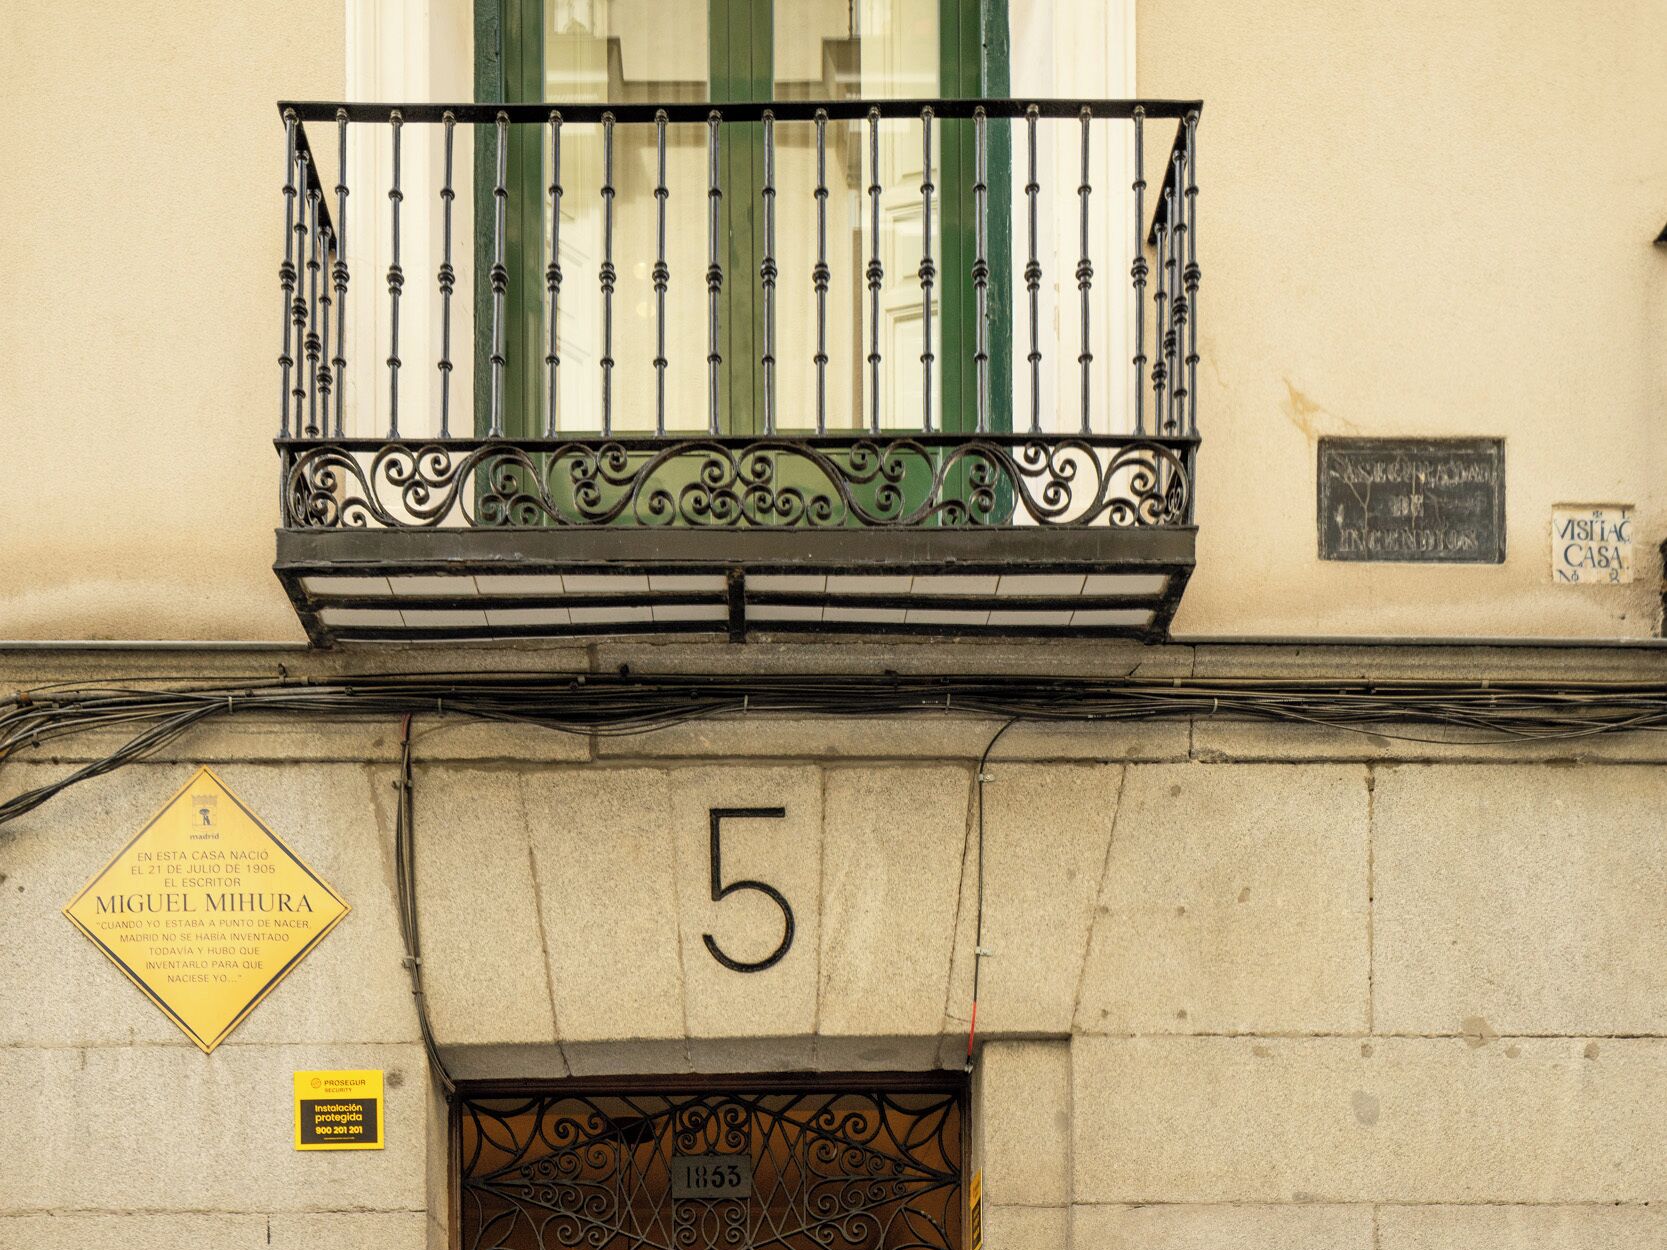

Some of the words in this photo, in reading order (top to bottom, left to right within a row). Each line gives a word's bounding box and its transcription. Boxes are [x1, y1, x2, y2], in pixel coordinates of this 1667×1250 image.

[137, 852, 152, 861] EN
[156, 851, 187, 860] ESTA
[191, 851, 226, 860] CASA
[230, 850, 269, 861] NACIÓ
[131, 865, 144, 875] EL
[148, 865, 161, 875] 21
[167, 865, 183, 874] DE
[186, 864, 221, 874] JULIO
[225, 864, 241, 874] DE
[247, 864, 276, 874] 1905
[164, 878, 178, 887] EL
[182, 878, 241, 887] ESCRITOR
[702, 807, 795, 973] 5
[96, 893, 197, 914] MIGUEL
[205, 893, 314, 912] MIHURA
[146, 920, 161, 928] YO
[165, 919, 205, 928] ESTABA
[208, 919, 216, 928] A
[219, 919, 254, 928] PUNTO
[257, 920, 272, 928] DE
[120, 934, 159, 943] MADRID
[162, 934, 177, 942] NO
[180, 933, 192, 942] SE
[195, 931, 227, 942] HABÍA
[230, 933, 290, 942] INVENTADO
[149, 945, 194, 956] TODAVÍA
[197, 946, 205, 955] Y
[207, 947, 236, 955] HUBO
[239, 947, 261, 956] QUE
[146, 961, 209, 970] INVENTARLO
[211, 960, 239, 969] PARA
[242, 961, 264, 970] QUE
[167, 974, 209, 983] NACIESE
[324, 1079, 366, 1087] PROSEGUR
[314, 1103, 363, 1113] Instalación
[315, 1112, 363, 1124] protegida
[315, 1126, 333, 1135] 900
[333, 1126, 348, 1135] 201
[349, 1125, 363, 1134] 201
[686, 1165, 742, 1189] 1853
